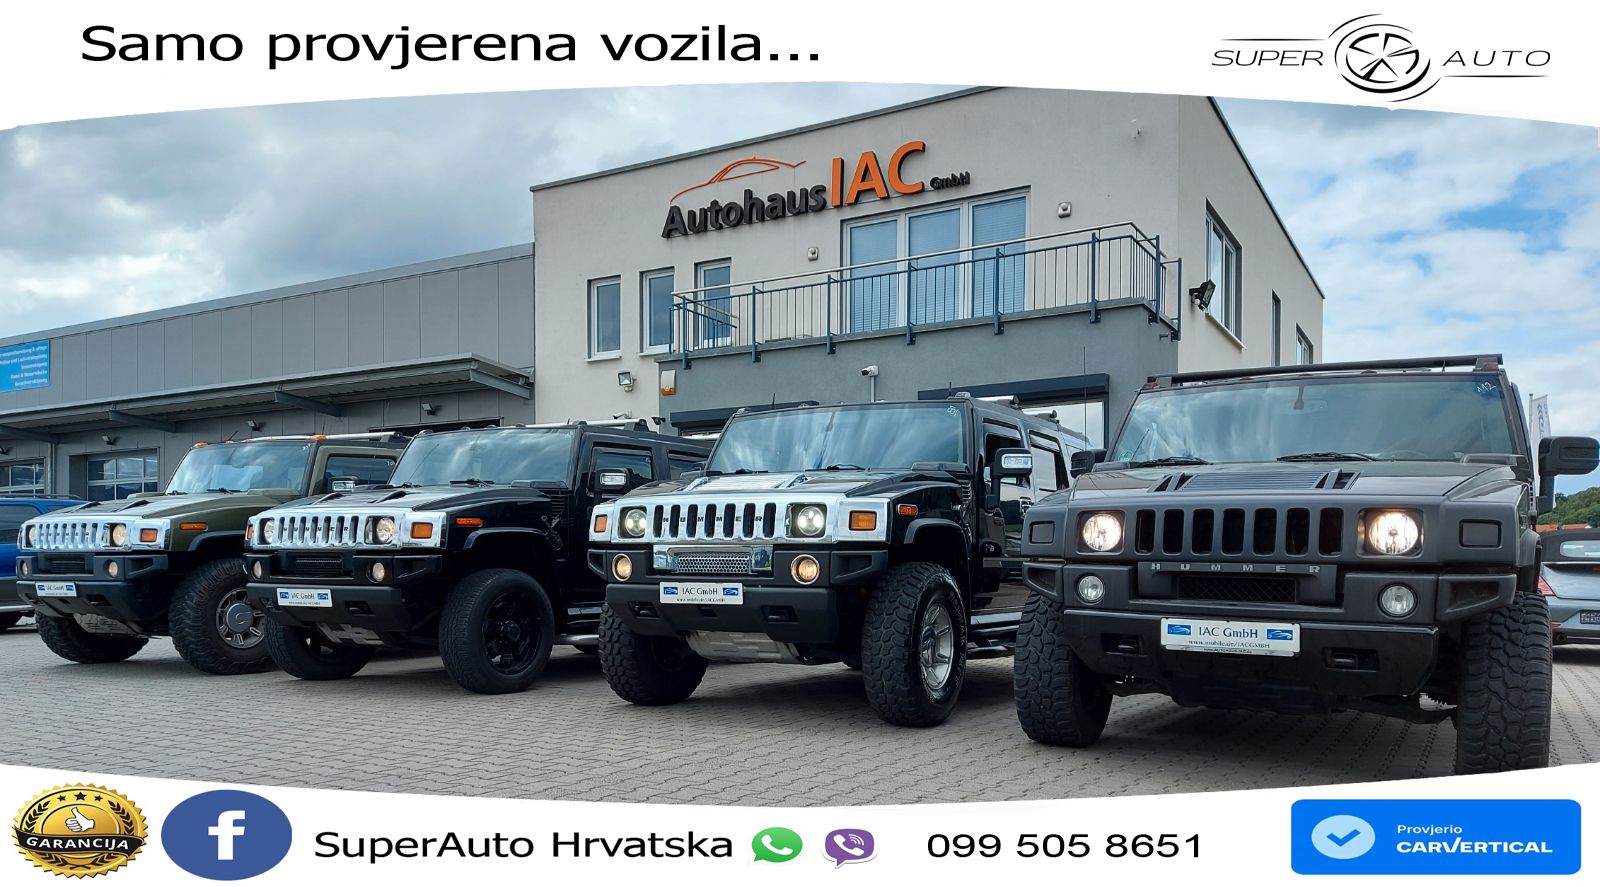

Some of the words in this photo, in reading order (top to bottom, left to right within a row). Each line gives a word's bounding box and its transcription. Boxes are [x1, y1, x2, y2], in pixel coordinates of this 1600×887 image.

[661, 184, 827, 238] Autohaus
[830, 140, 926, 208] IAC
[929, 171, 971, 190] GmbH
[1151, 563, 1320, 573] HUMMER
[697, 588, 718, 596] GmbH
[1199, 626, 1220, 637] IAC
[1223, 628, 1258, 639] GmbH
